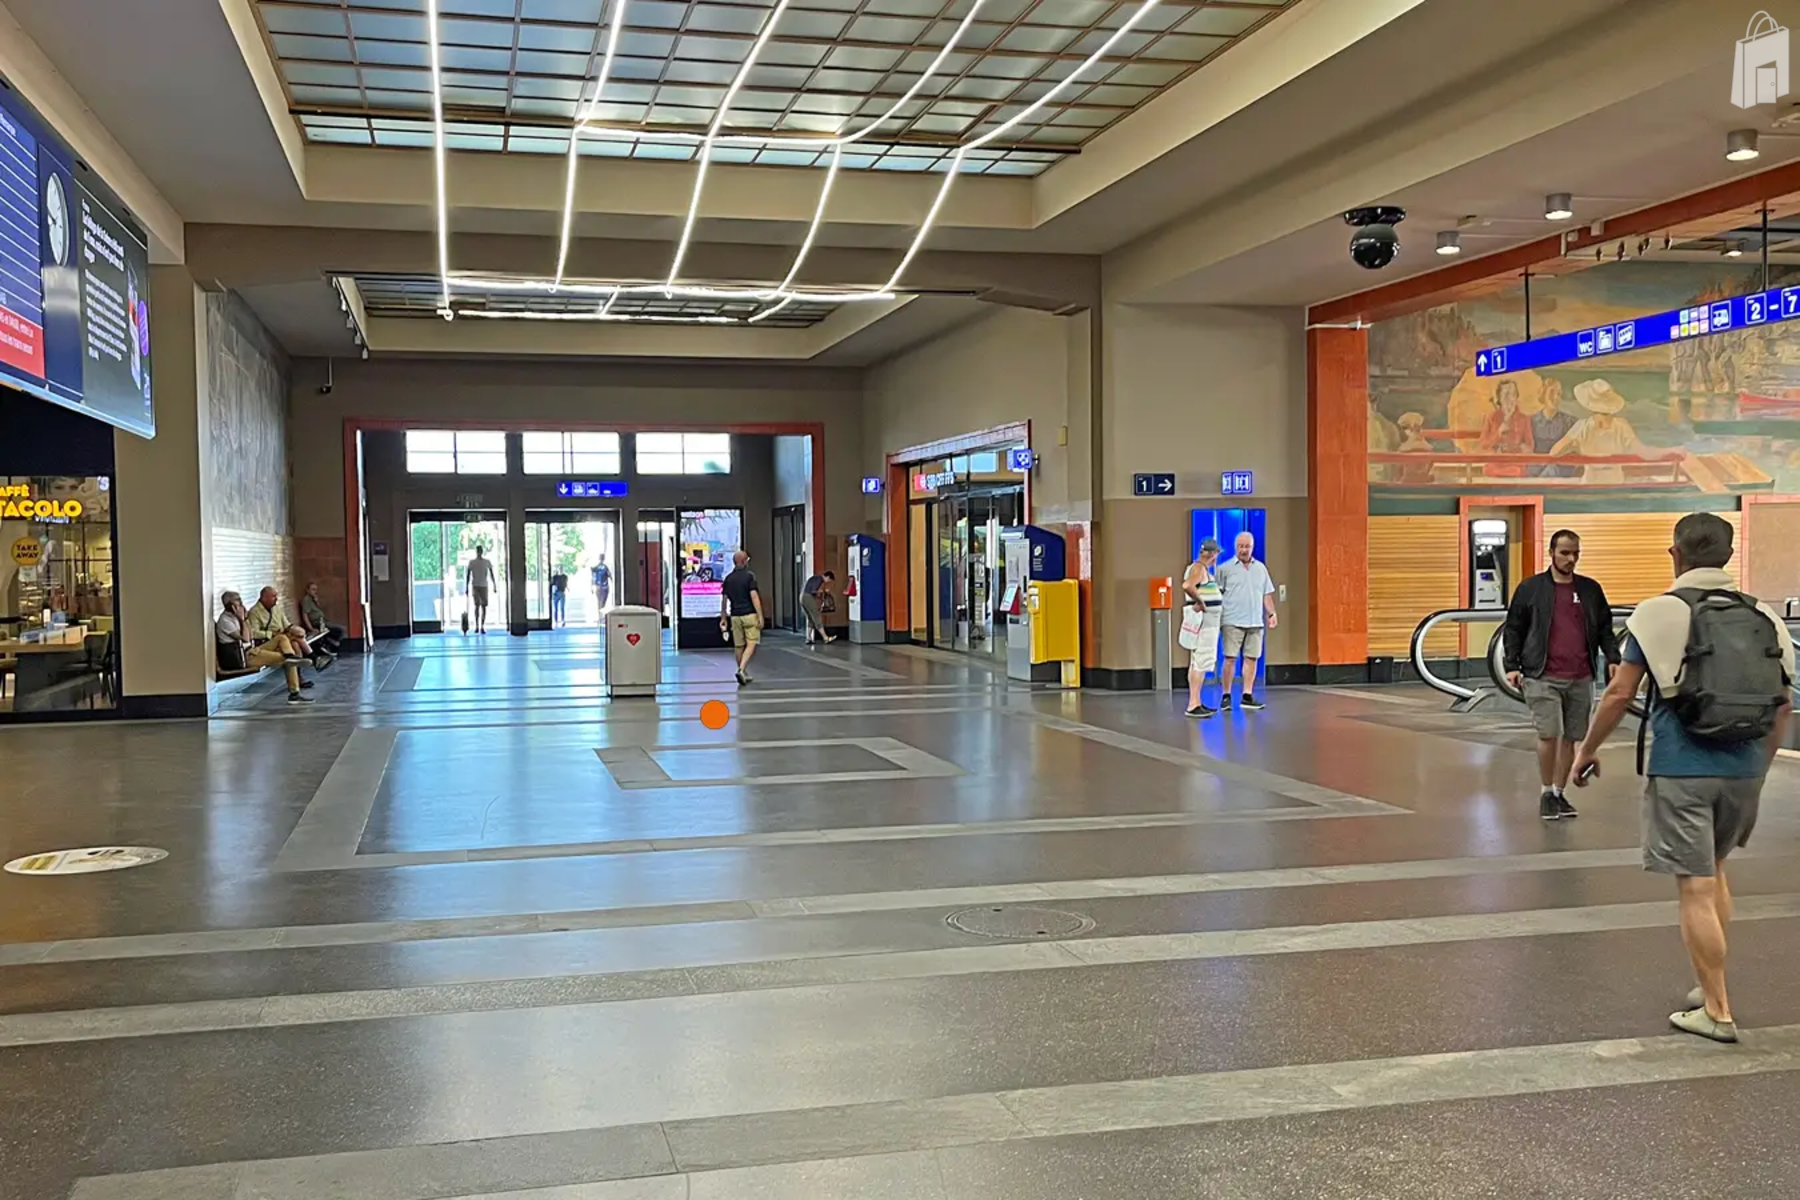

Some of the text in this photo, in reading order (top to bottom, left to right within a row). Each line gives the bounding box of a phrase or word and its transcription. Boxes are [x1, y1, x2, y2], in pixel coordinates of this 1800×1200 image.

[1495, 354, 1501, 369] 1
[1579, 341, 1593, 354] WC
[1751, 302, 1761, 321] 2
[1787, 295, 1798, 313] 7
[1142, 480, 1147, 492] 1
[16, 544, 38, 552] TAKE
